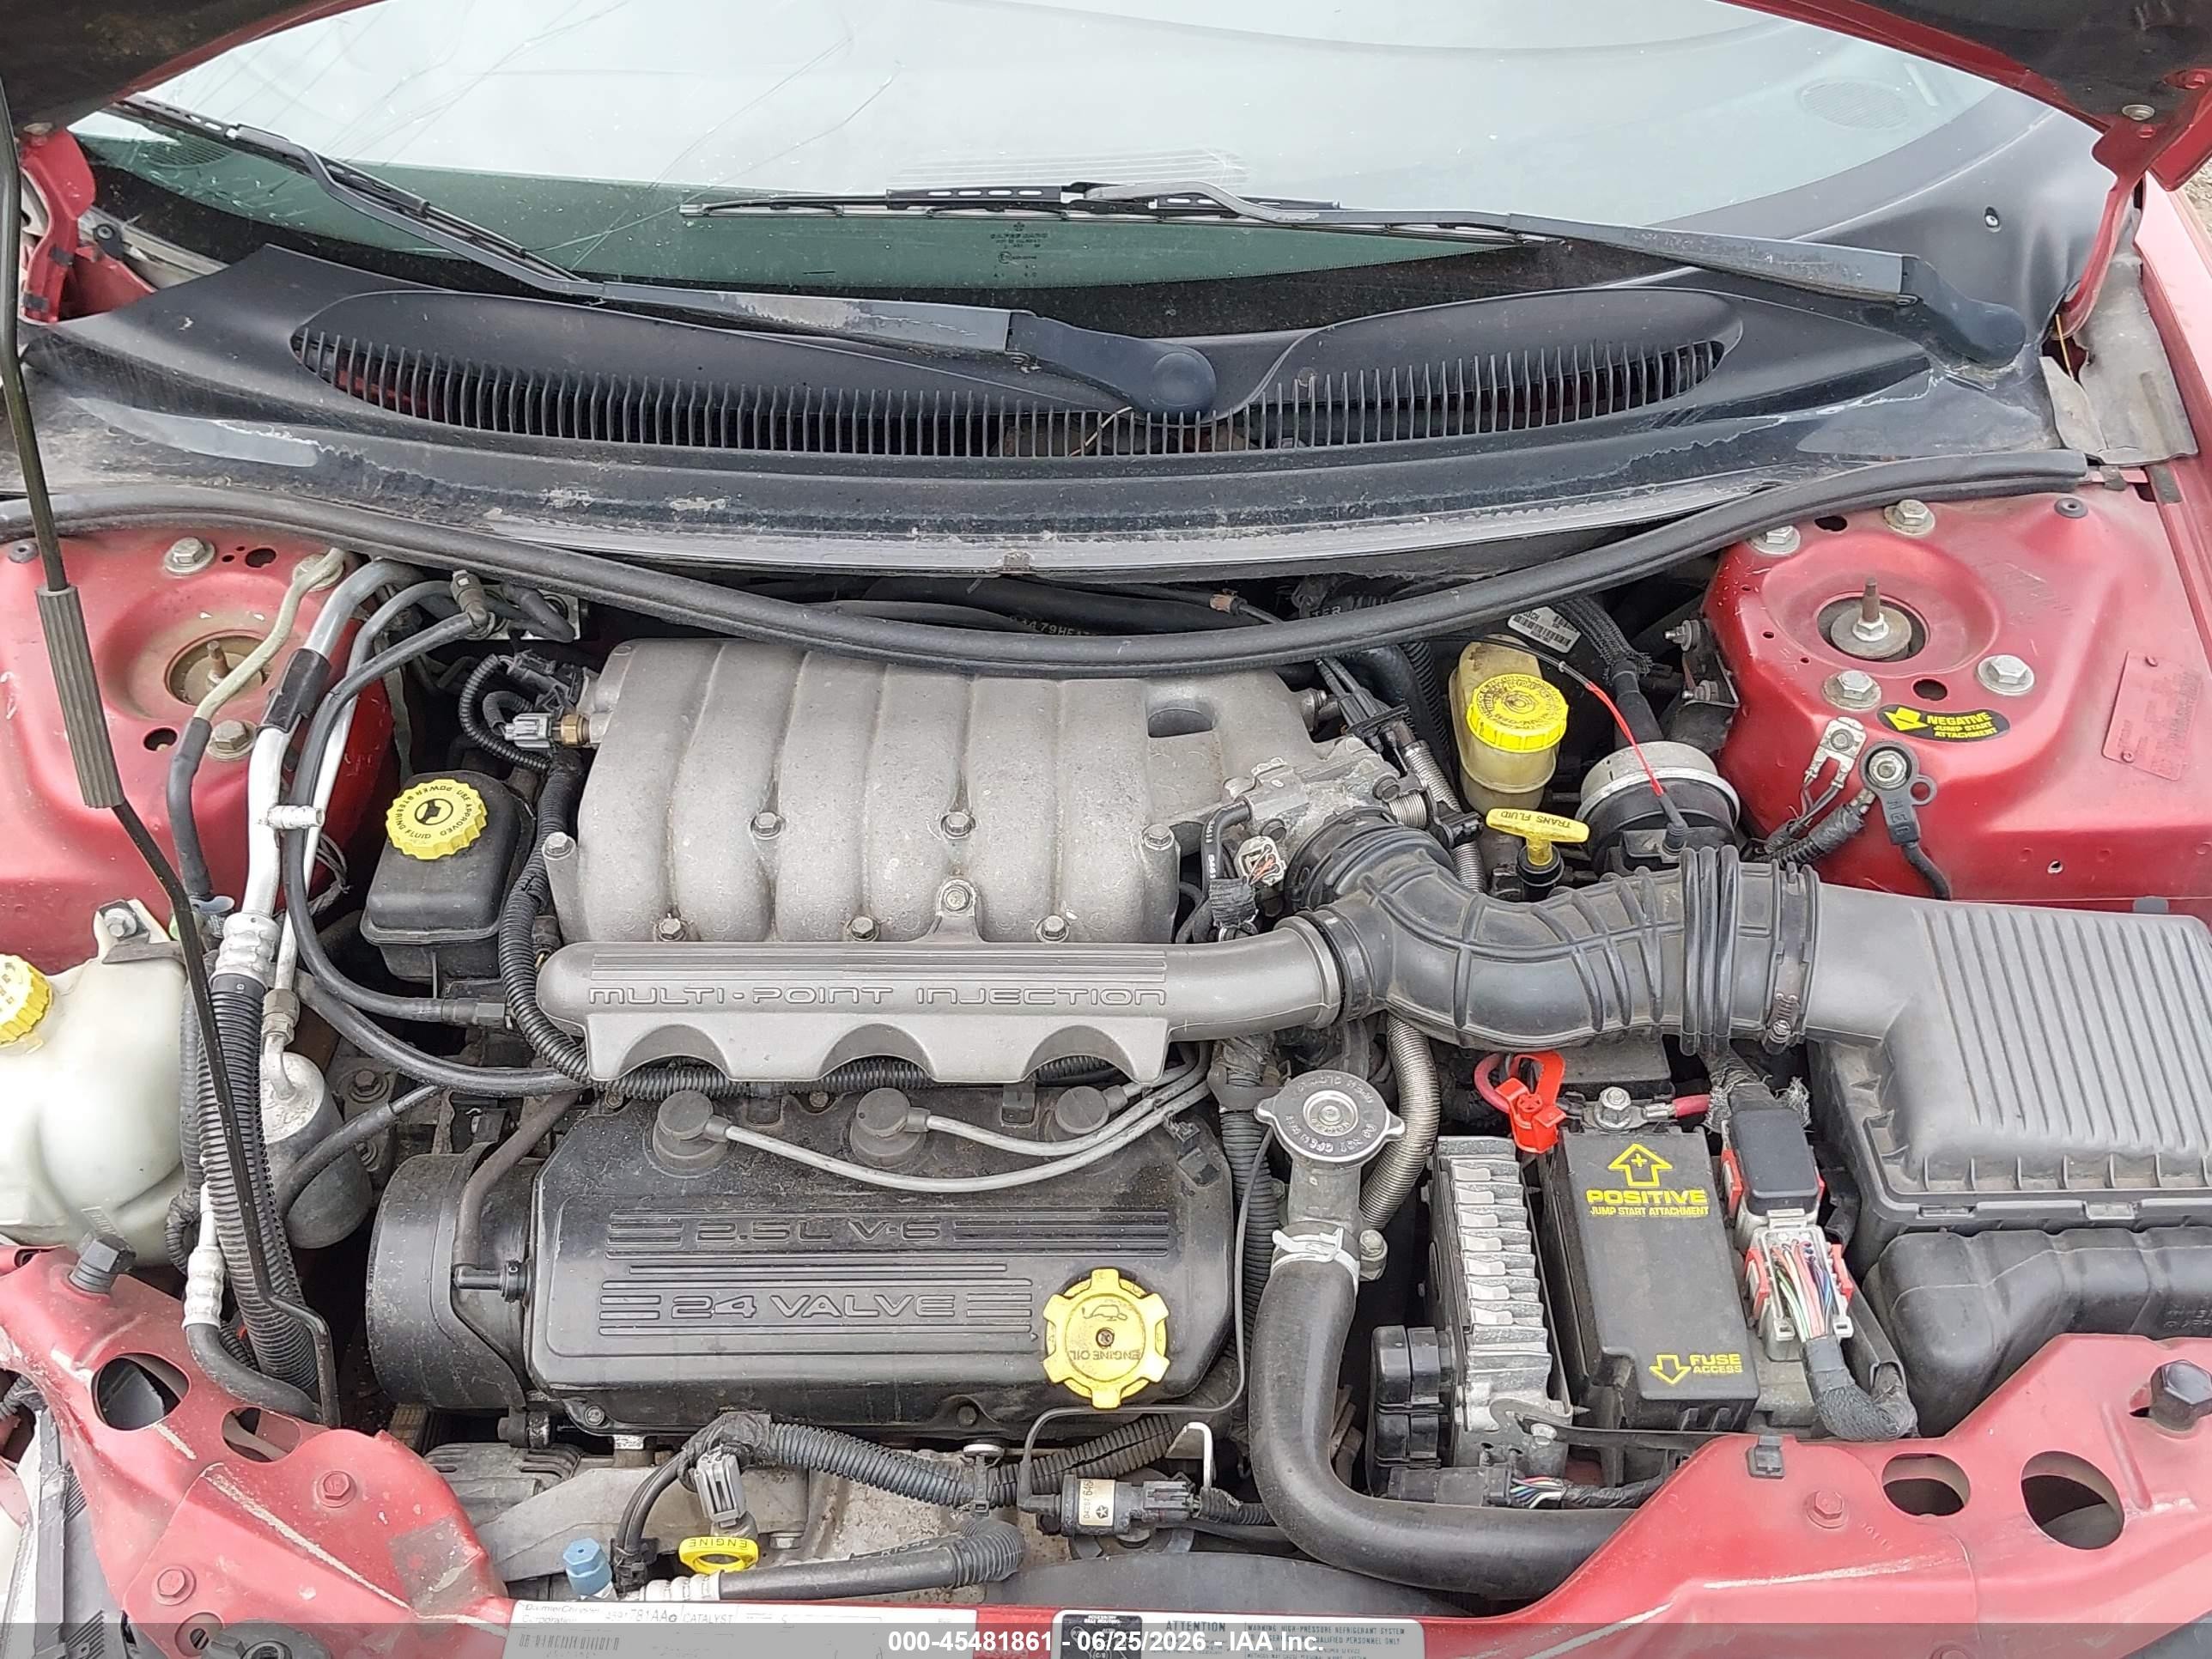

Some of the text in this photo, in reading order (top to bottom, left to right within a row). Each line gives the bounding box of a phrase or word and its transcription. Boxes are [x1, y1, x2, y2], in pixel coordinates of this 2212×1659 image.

[1927, 712, 1992, 726] NEGATIVE
[1964, 721, 1993, 731] START
[1934, 727, 1997, 738] ATTACHMENT
[395, 785, 473, 839] USE APPROVED POWER STEERING FLUID
[1500, 811, 1571, 829] TRANS FLUID
[917, 988, 1166, 1005] INJECTION
[1586, 1189, 1709, 1205] POSITIVE
[1590, 1206, 1709, 1216] JUMP START ATTACHMENT
[696, 1221, 833, 1243] 2.5L
[671, 1294, 956, 1319] 24 VALVE
[1069, 1350, 1141, 1361] ENGINE OIL
[1689, 1353, 1742, 1366] FUSE
[1692, 1365, 1744, 1374] ACCESS
[688, 1538, 748, 1548] ENGINE
[683, 1613, 734, 1624] CATALYST
[1166, 1620, 1225, 1632] ATTENTION
